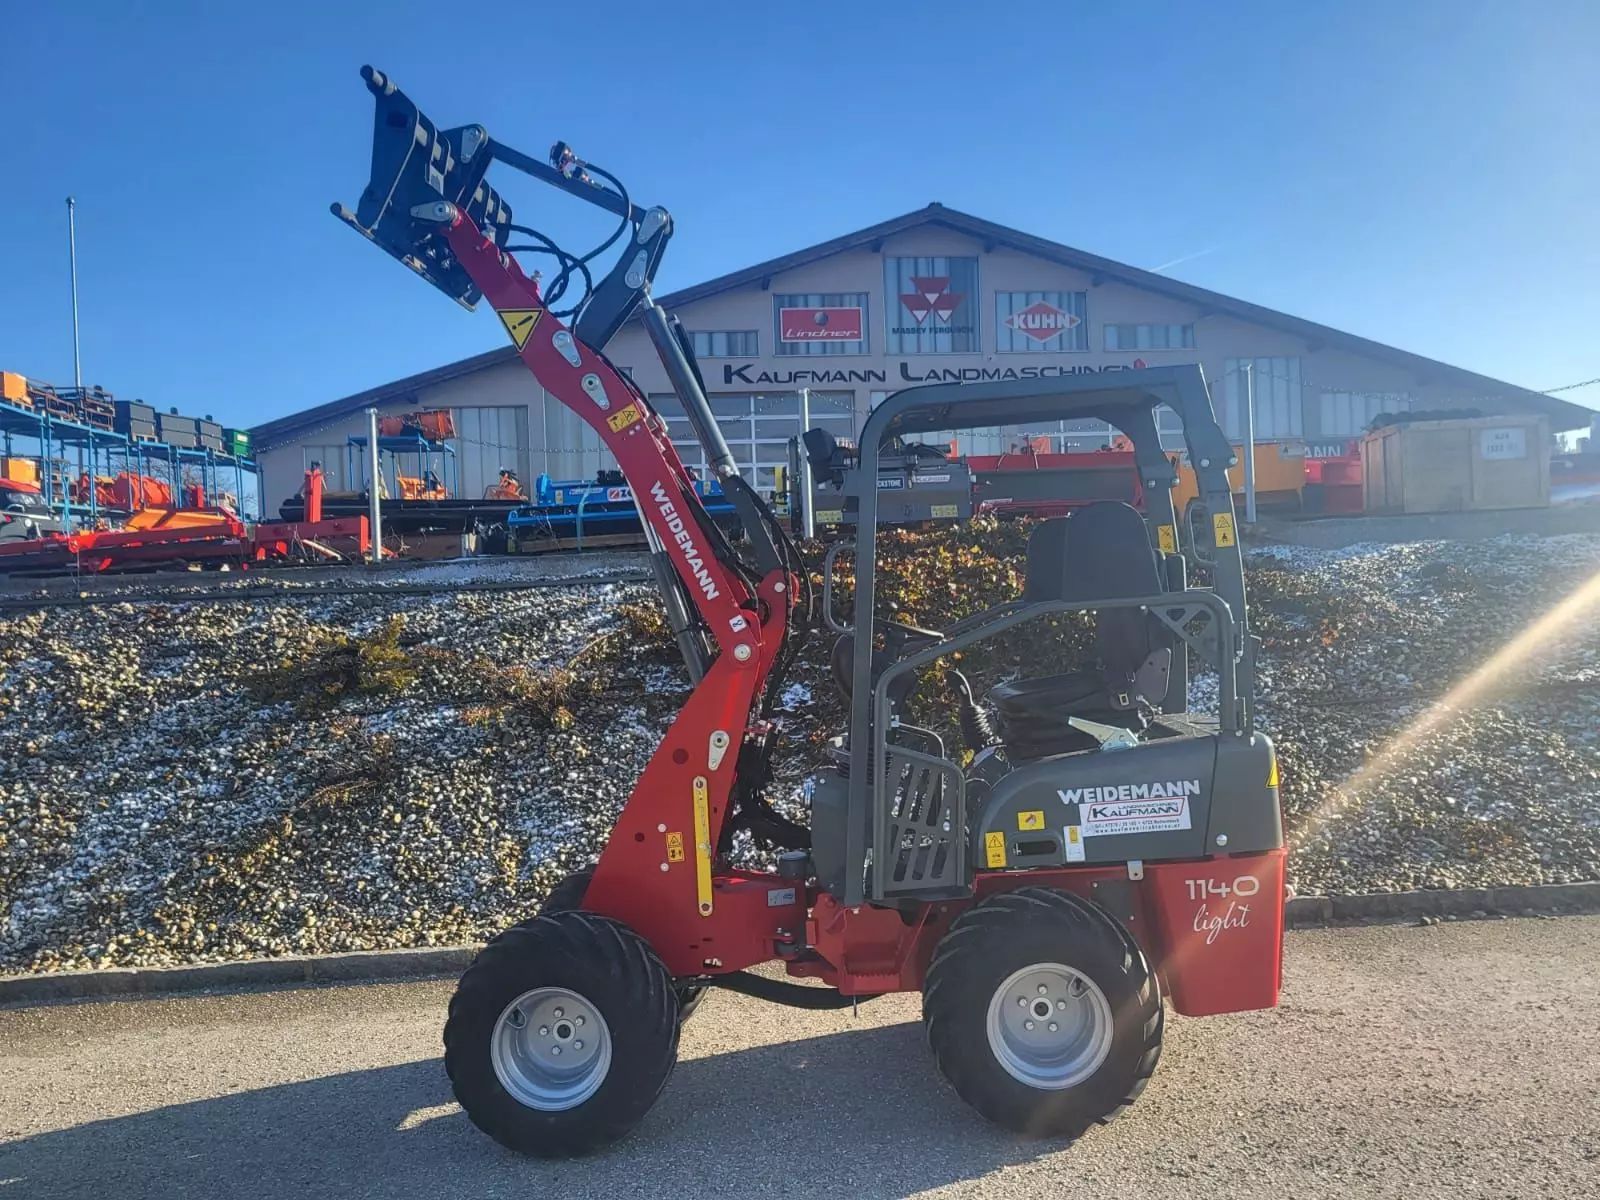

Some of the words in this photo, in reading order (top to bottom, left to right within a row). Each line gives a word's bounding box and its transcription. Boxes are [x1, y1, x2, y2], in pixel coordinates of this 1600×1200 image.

[891, 327, 926, 335] MASSEY
[1013, 312, 1071, 329] KUHN
[785, 328, 859, 338] Lindner
[723, 363, 887, 385] KAUFMANN
[650, 480, 720, 601] WEIDEMANN
[1056, 779, 1201, 805] WEIDEMANN
[1092, 805, 1179, 819] KAUFMANN
[1184, 875, 1260, 900] 1140
[1193, 901, 1252, 945] light
